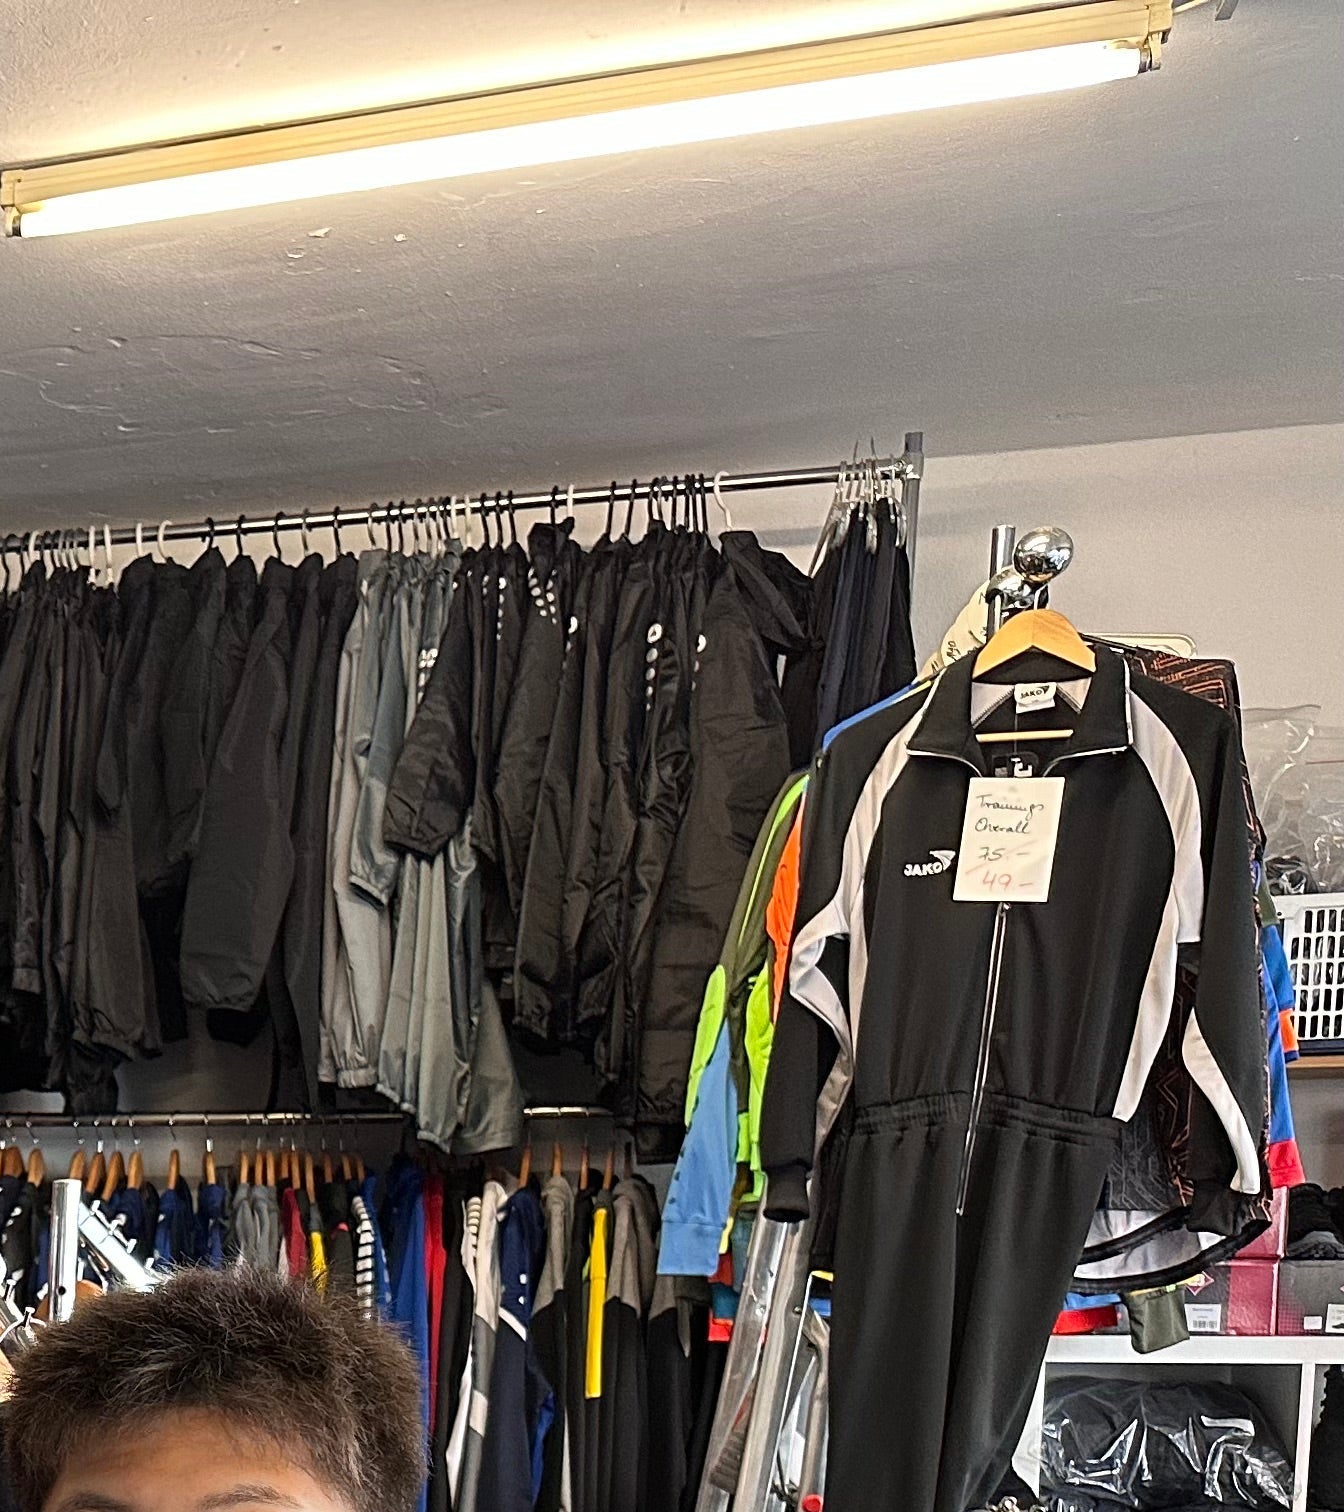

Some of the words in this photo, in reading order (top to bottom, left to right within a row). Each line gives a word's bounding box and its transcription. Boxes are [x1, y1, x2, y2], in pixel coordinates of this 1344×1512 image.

[1020, 689, 1043, 700] JAKO
[975, 818, 1030, 834] Overall
[904, 863, 943, 876] JAKO
